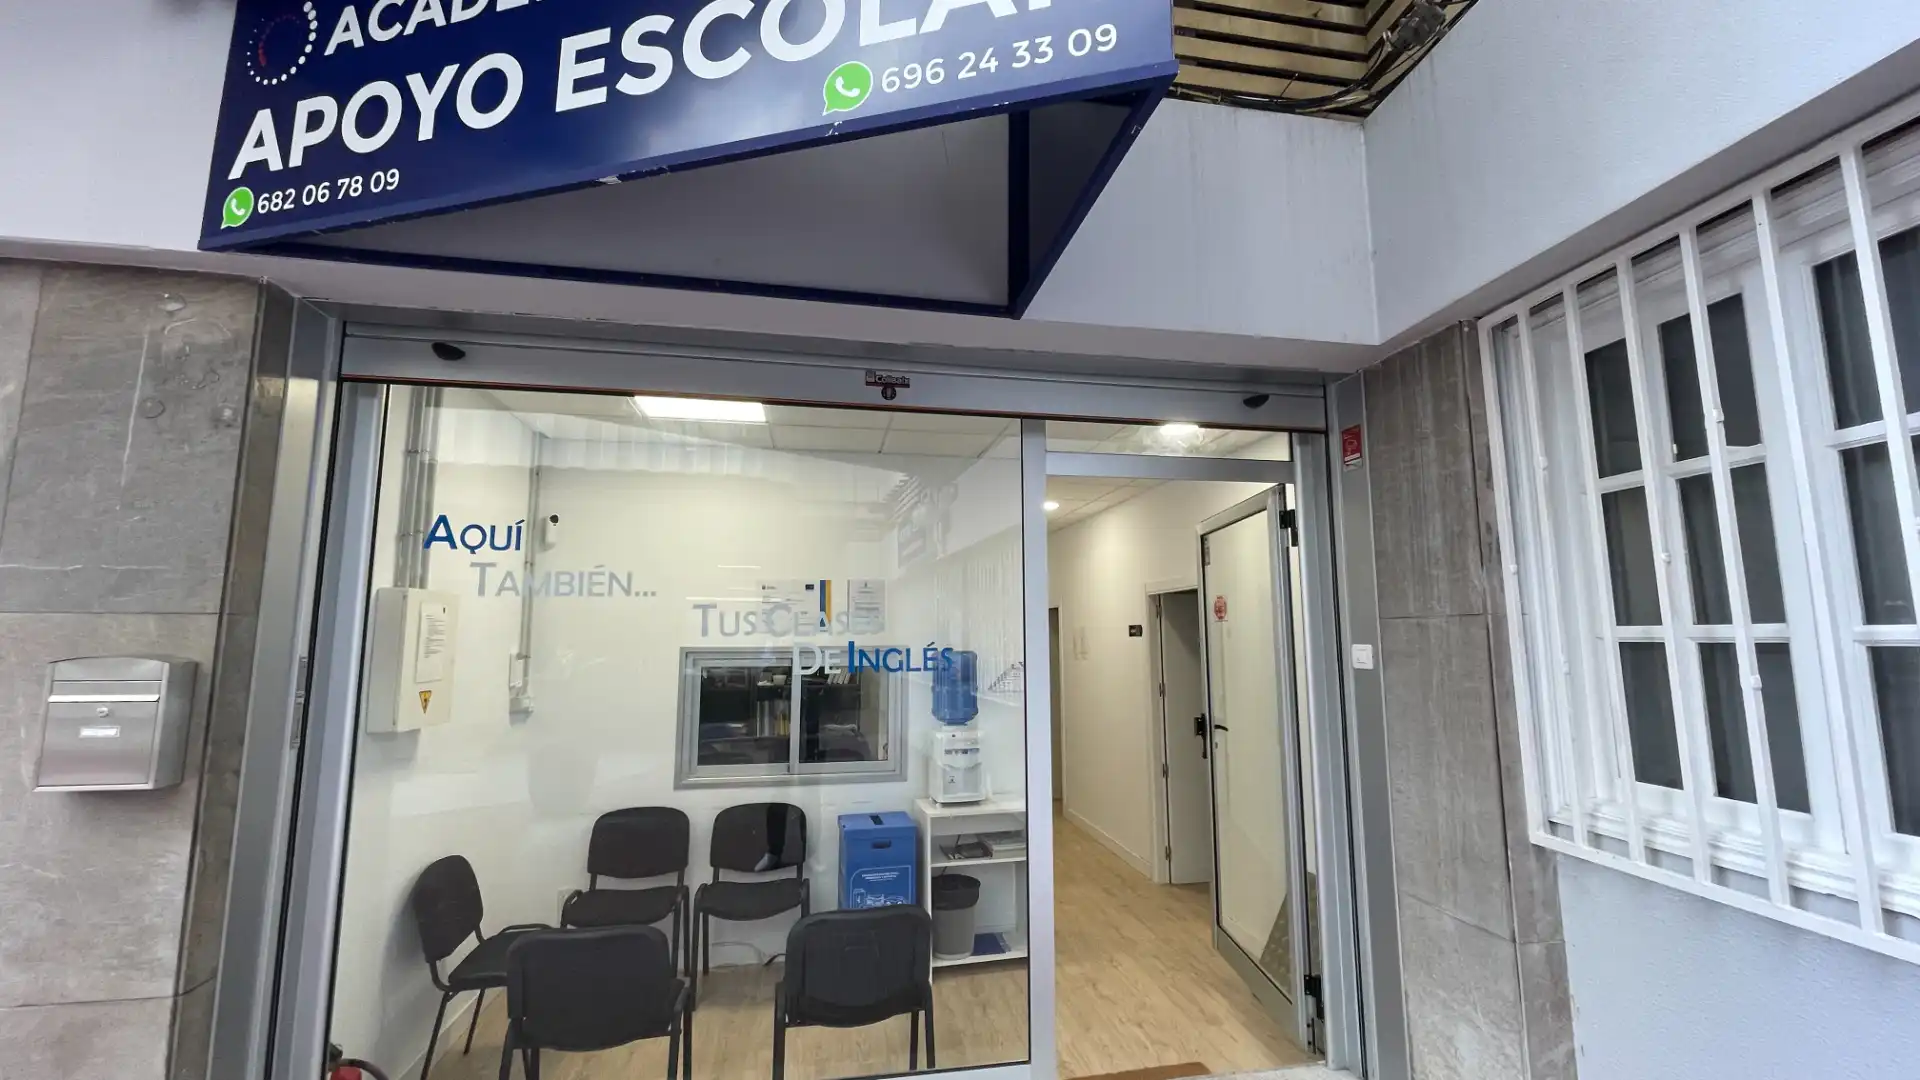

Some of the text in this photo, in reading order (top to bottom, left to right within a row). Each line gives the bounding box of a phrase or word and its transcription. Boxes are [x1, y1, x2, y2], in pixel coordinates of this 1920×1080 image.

[324, 0, 541, 56] ACAD
[881, 23, 1118, 93] 696 24 33 09
[228, 0, 1052, 180] APOYO ESCOL
[256, 169, 400, 214] 682 06 78 09
[423, 514, 526, 555] AQUÍ
[692, 603, 757, 637] TUS
[792, 640, 954, 676] DE INGLÉS
